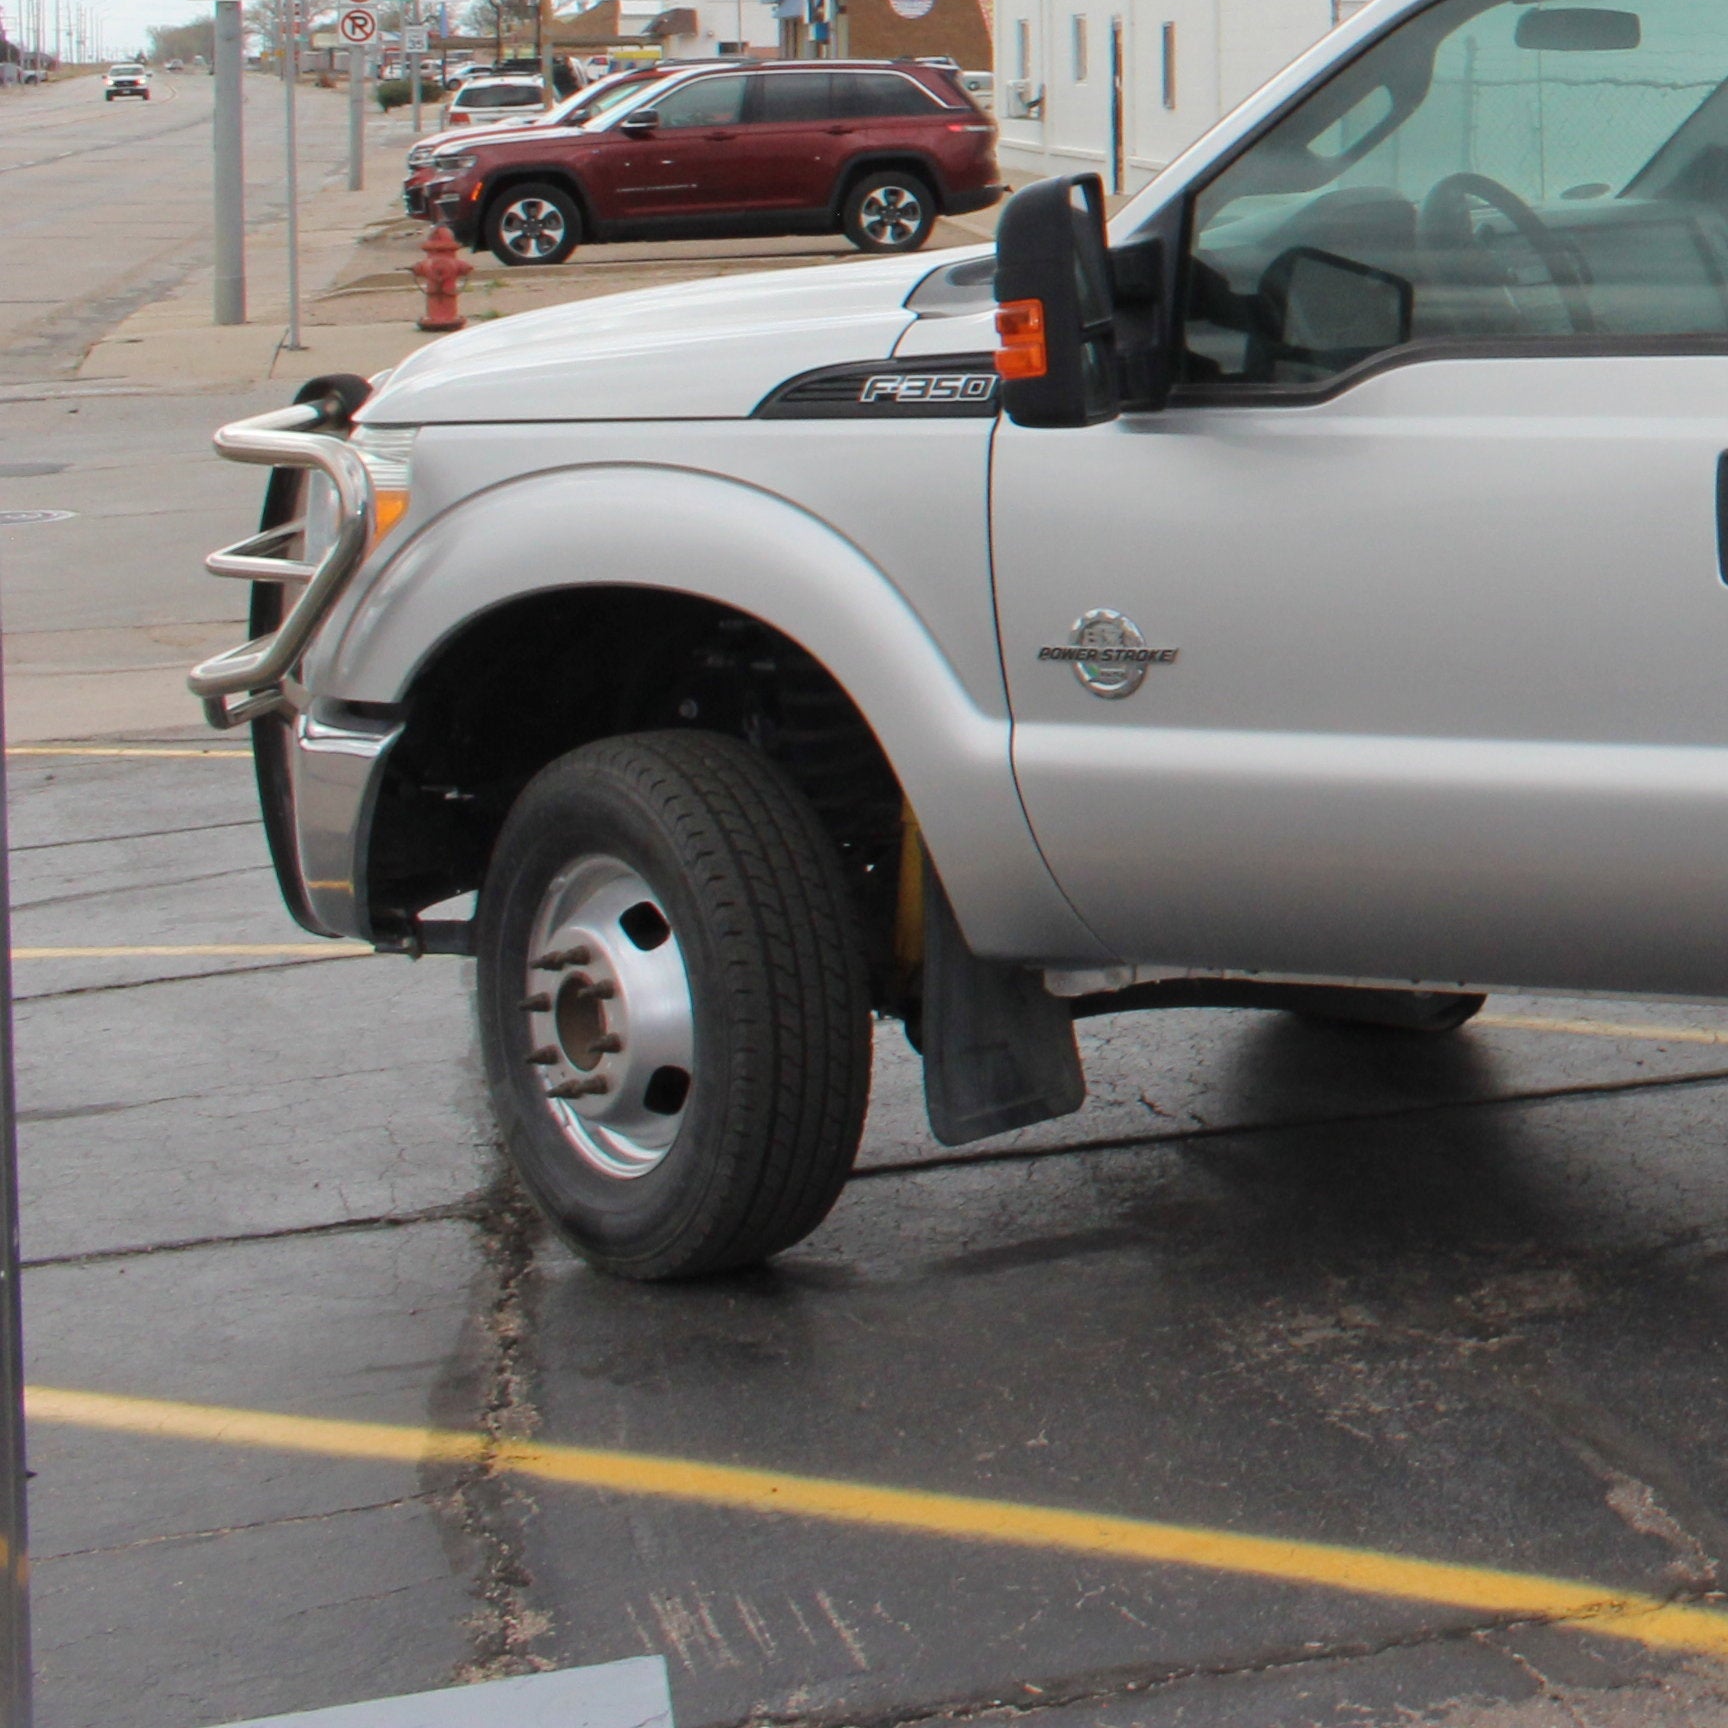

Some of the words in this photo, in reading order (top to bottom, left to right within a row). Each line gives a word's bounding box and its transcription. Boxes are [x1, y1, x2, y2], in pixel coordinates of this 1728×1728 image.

[860, 373, 999, 403] F-350
[1038, 646, 1099, 662] POWER
[1101, 648, 1174, 663] STROKE
